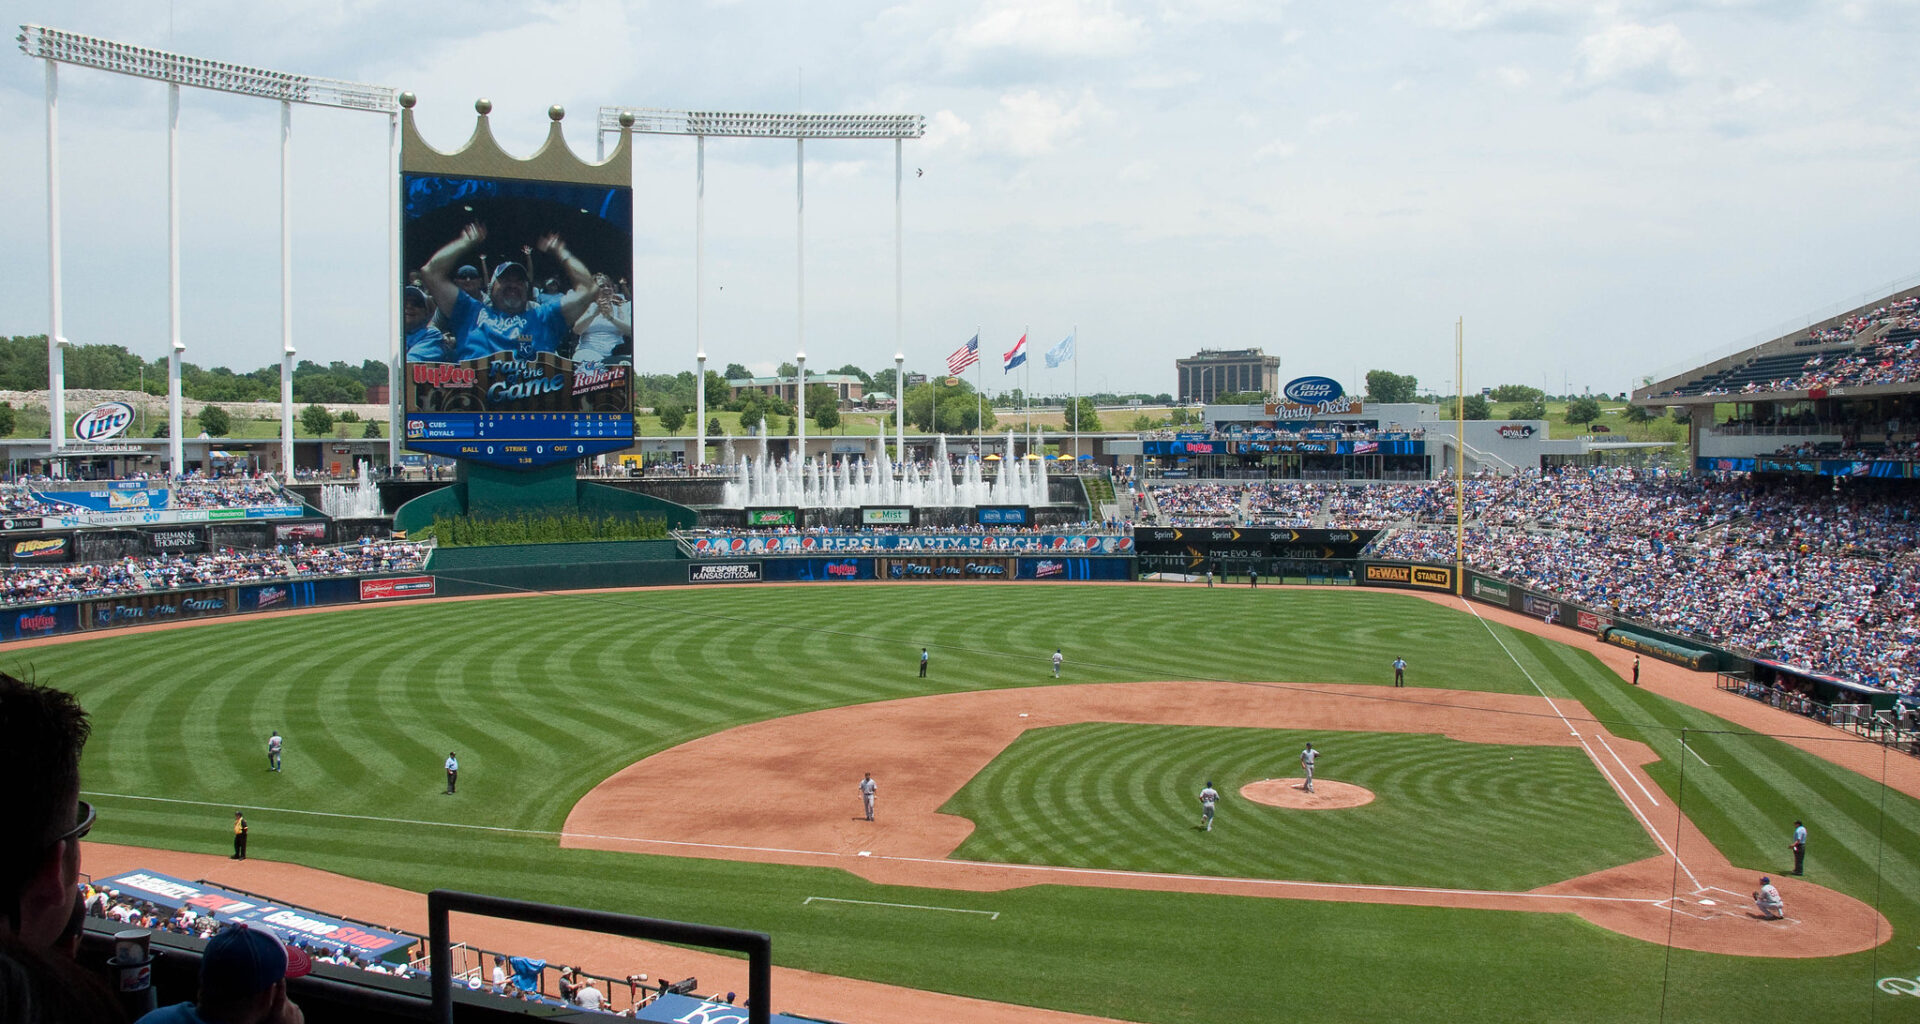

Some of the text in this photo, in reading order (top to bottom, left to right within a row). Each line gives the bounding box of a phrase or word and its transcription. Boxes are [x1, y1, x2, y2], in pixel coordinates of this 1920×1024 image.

[489, 359, 527, 377] Fan
[521, 367, 544, 378] the
[573, 367, 625, 389] Roberts
[487, 373, 566, 402] Game
[1300, 383, 1331, 391] BUD
[1274, 397, 1351, 421] Party Deck
[87, 412, 127, 440] Lite
[1502, 429, 1530, 437] RIVALS
[487, 445, 494, 454] 0
[536, 445, 543, 454] 0
[577, 445, 584, 454] 0
[1250, 442, 1270, 452] Fan
[1296, 442, 1328, 452] Game
[88, 514, 136, 525] Kansas City
[882, 510, 902, 519] Mist
[187, 529, 195, 539] &
[1154, 530, 1174, 540] Sprint
[1212, 530, 1231, 540] Sprint
[1270, 531, 1290, 541] Sprint
[1329, 532, 1349, 542] Sprint
[15, 540, 38, 554] 610
[154, 538, 195, 548] THOMPSON
[822, 537, 879, 550] PEPSI
[899, 537, 962, 550] PARTY
[1230, 549, 1249, 557] EVO
[1250, 549, 1262, 557] 4G
[1283, 545, 1318, 558] Sprint
[1140, 550, 1185, 568] Sprint
[904, 563, 931, 575] Fan
[945, 564, 961, 574] the
[965, 562, 1004, 575] Game
[1416, 571, 1446, 582] STANLEY
[114, 605, 144, 618] Fan
[160, 604, 177, 614] the
[182, 598, 225, 611] Game
[263, 910, 397, 950] GameStop
